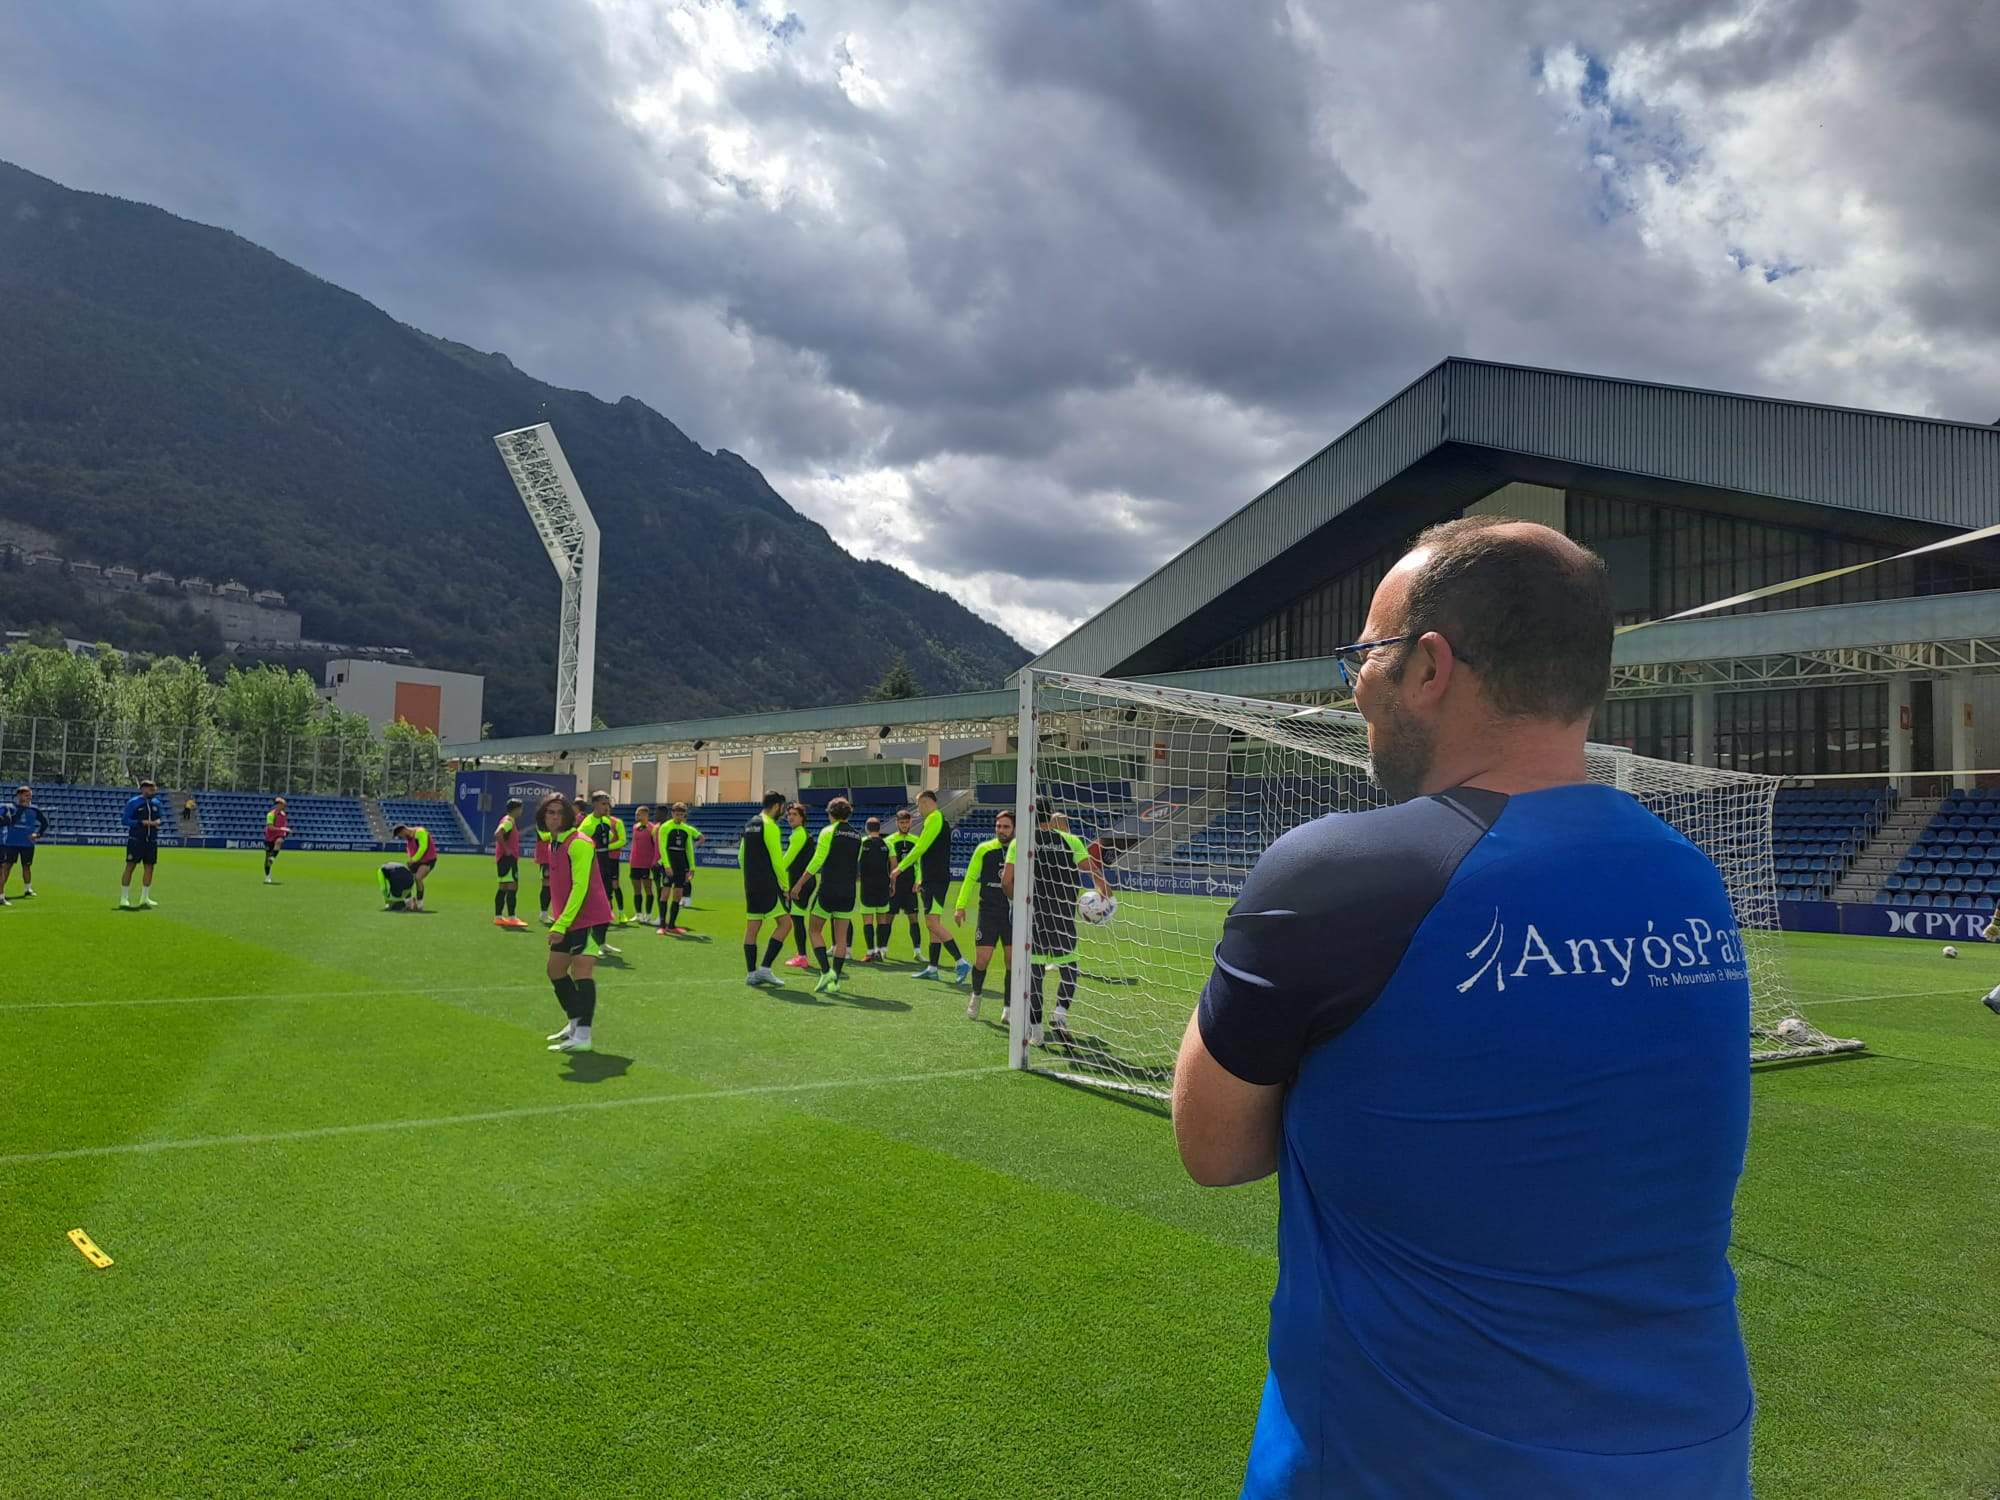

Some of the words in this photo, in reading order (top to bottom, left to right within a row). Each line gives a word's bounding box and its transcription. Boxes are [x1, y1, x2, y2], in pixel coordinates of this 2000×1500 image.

[1124, 876, 1200, 890] visitandorra.com
[1220, 880, 1244, 894] And
[1923, 912, 1994, 938] PYR
[1648, 974, 1669, 988] The
[1671, 970, 1717, 986] Mountain
